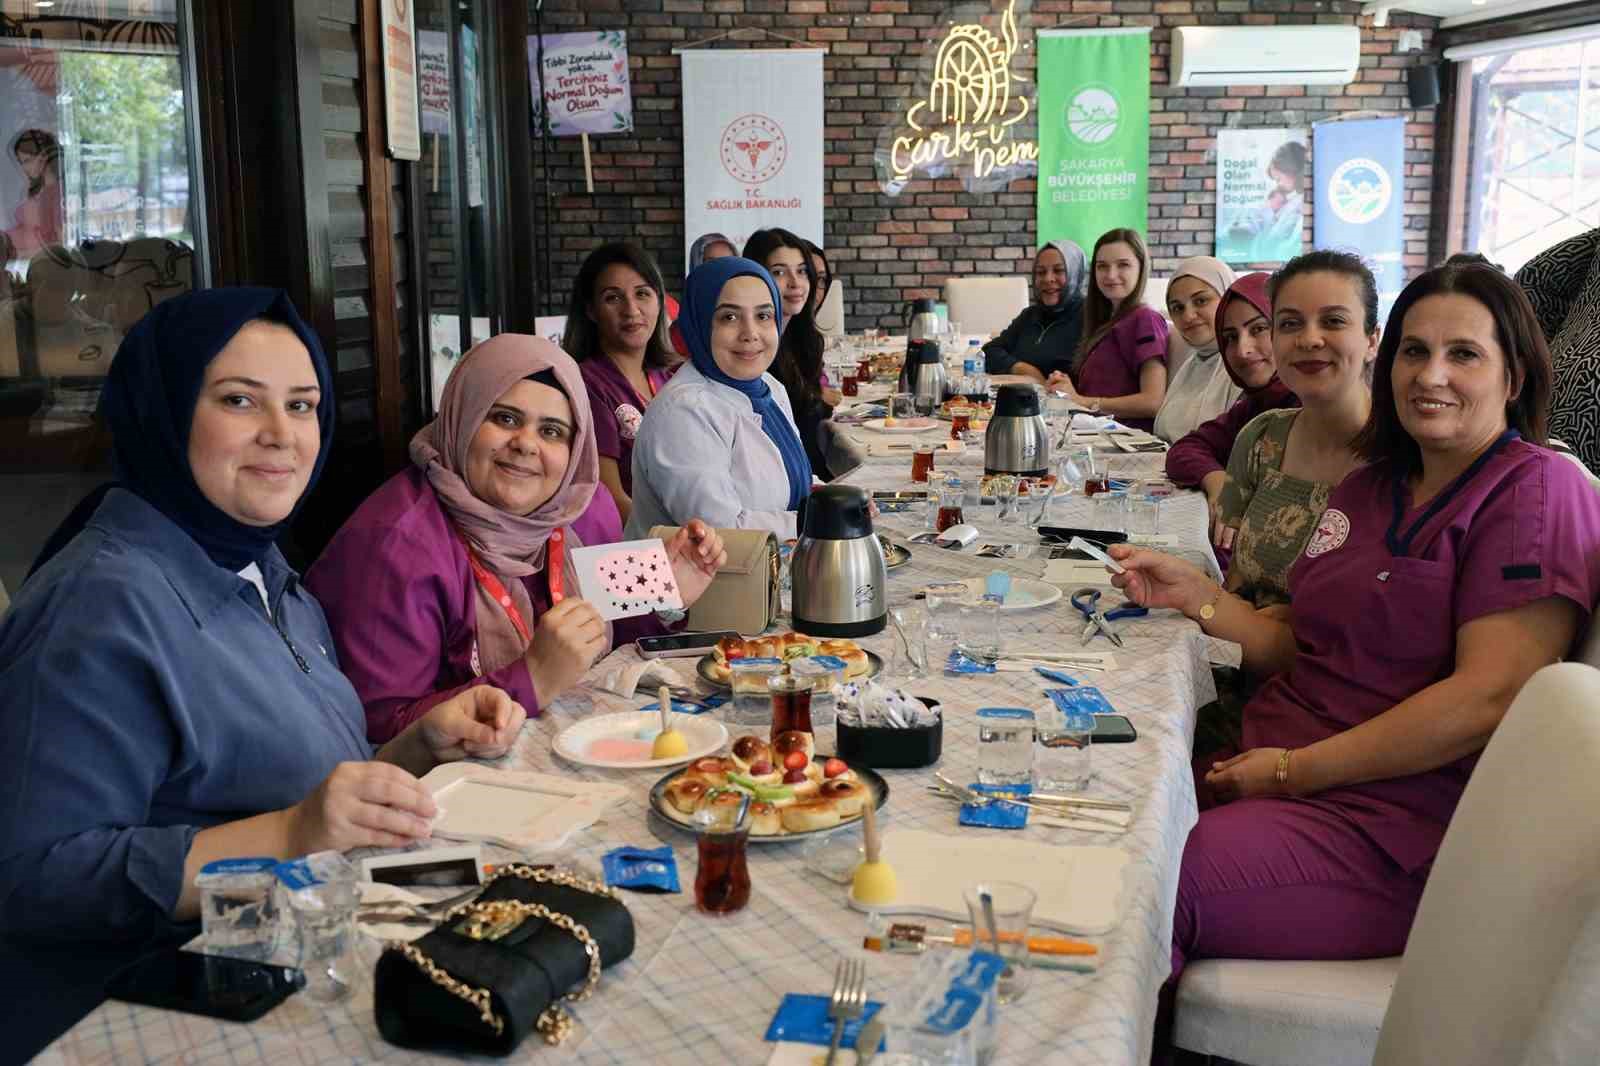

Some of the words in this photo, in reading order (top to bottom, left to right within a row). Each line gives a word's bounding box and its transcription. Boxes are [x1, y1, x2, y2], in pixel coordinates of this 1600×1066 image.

[557, 73, 608, 88] Tercihiniz
[544, 84, 586, 103] Normal
[588, 84, 624, 99] Doğum
[567, 99, 600, 112] Olsun
[974, 142, 1040, 178] Dem
[1060, 158, 1125, 171] SAKARYA
[1047, 171, 1137, 188] BÜYÜKŞEHİR
[1223, 182, 1266, 192] Normal
[1052, 188, 1131, 203] BELEDİYESİ
[705, 198, 742, 211] SAĞLIK
[745, 197, 802, 210] BAKANLIĞI
